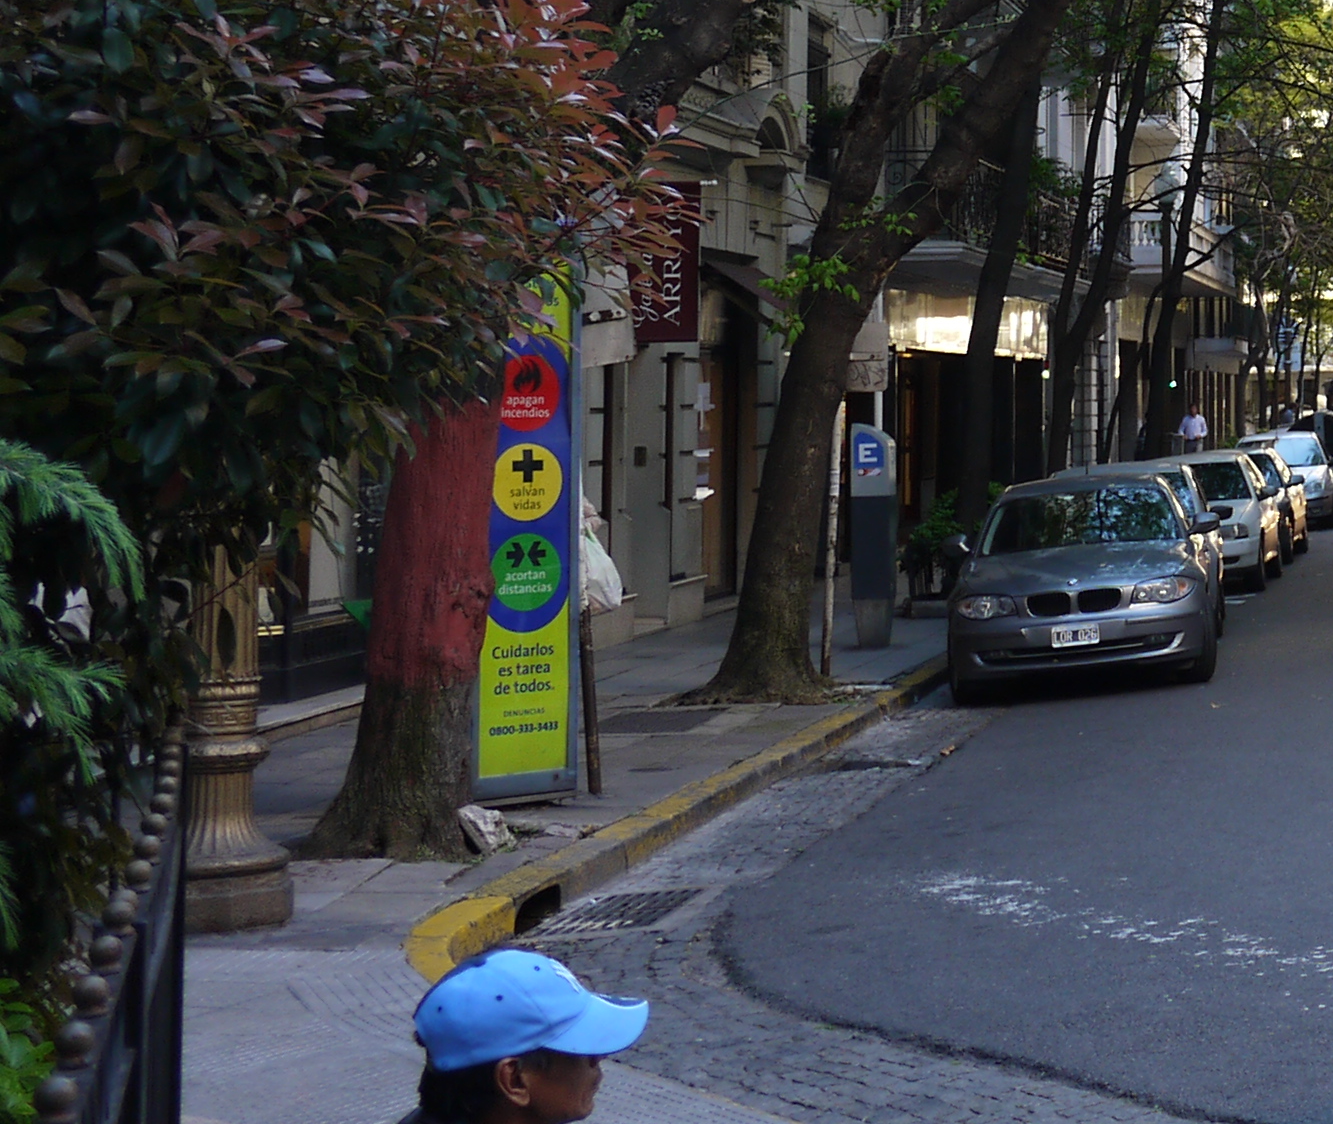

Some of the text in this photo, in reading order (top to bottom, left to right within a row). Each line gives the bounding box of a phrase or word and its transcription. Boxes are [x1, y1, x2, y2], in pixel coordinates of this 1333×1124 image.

[506, 395, 545, 407] apagan
[501, 408, 550, 418] incendios
[858, 443, 878, 463] E
[509, 486, 545, 498] salvan
[513, 500, 541, 510] vidas
[505, 570, 546, 582] acortan
[498, 583, 553, 595] distancias
[492, 643, 555, 660] Cuidarlos
[498, 663, 551, 677] es tarea
[494, 678, 555, 695] de todos.
[503, 707, 545, 717] DENUNCIAS
[489, 721, 558, 736] 0800-333-3433
